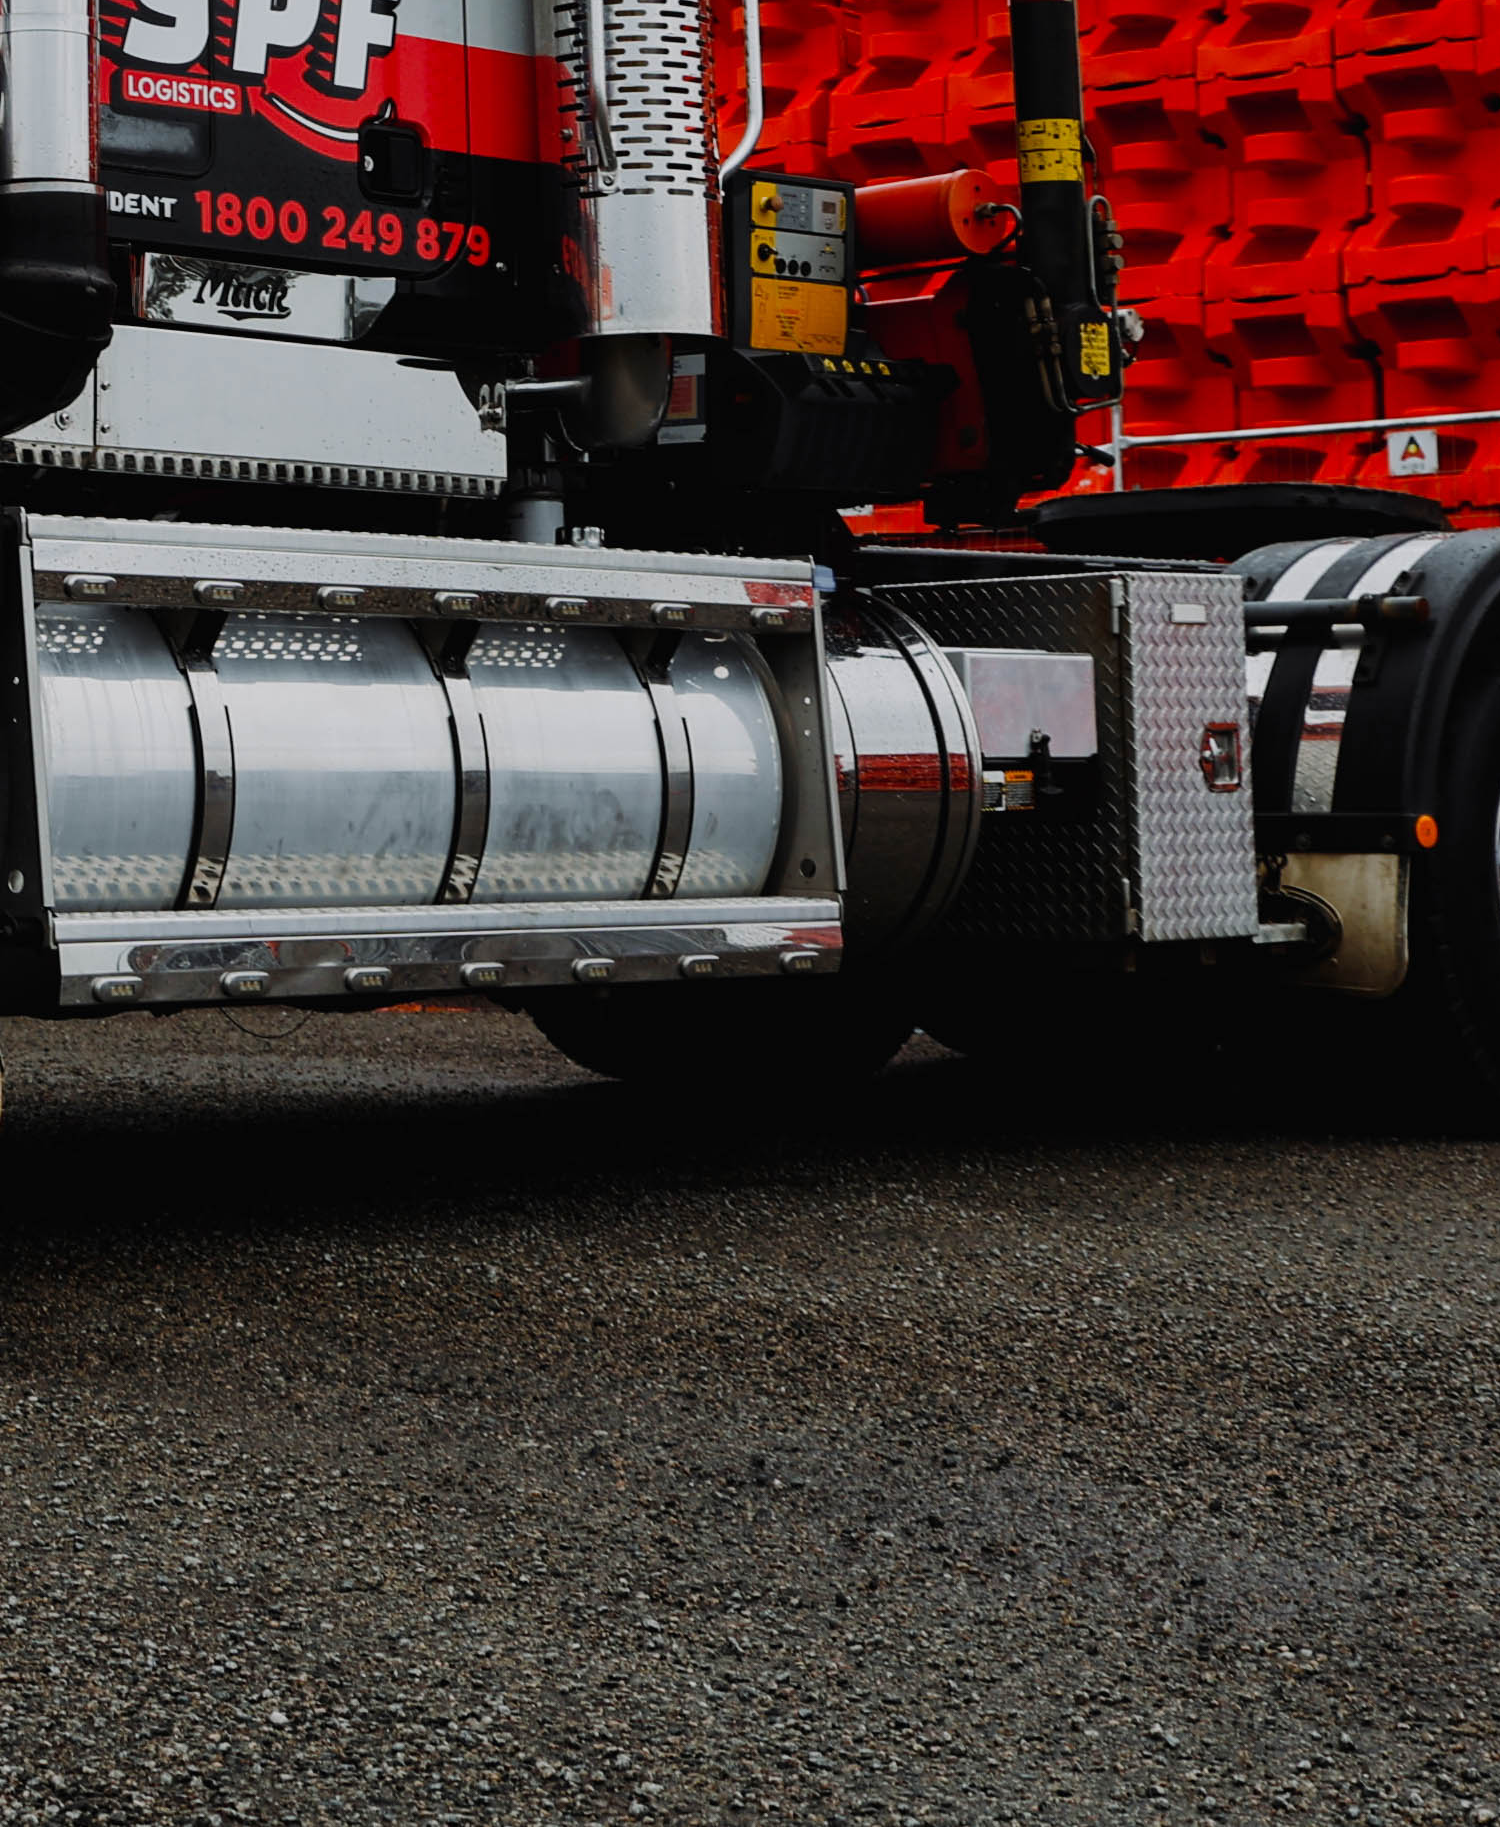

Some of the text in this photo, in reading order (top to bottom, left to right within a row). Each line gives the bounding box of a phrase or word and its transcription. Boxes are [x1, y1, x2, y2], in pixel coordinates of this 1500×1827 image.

[127, 75, 237, 110] LOGISTICS
[193, 189, 492, 267] 1800 249 879
